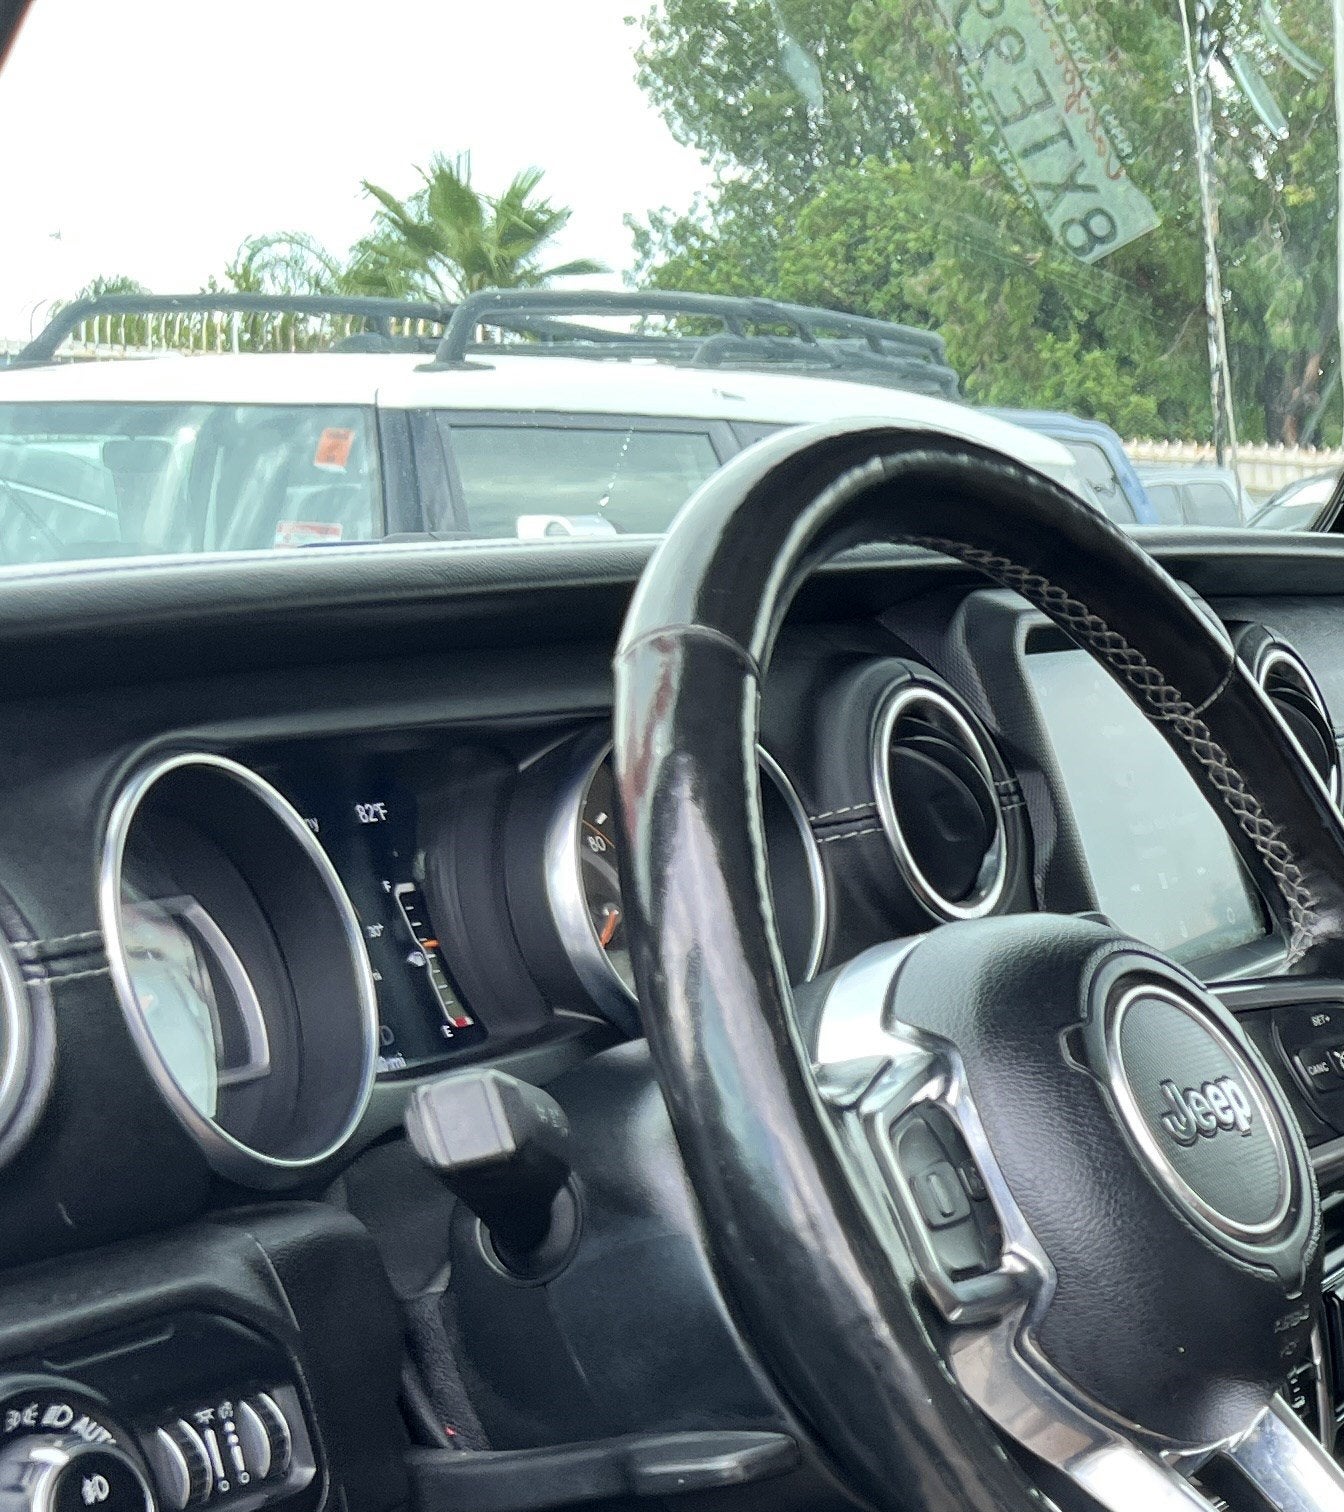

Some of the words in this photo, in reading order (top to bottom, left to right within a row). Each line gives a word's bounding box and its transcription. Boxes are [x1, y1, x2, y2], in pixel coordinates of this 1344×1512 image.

[587, 835, 607, 852] 80
[1307, 1061, 1330, 1076] CANC
[1160, 1077, 1252, 1146] Jeep
[71, 1413, 117, 1445] AUT
